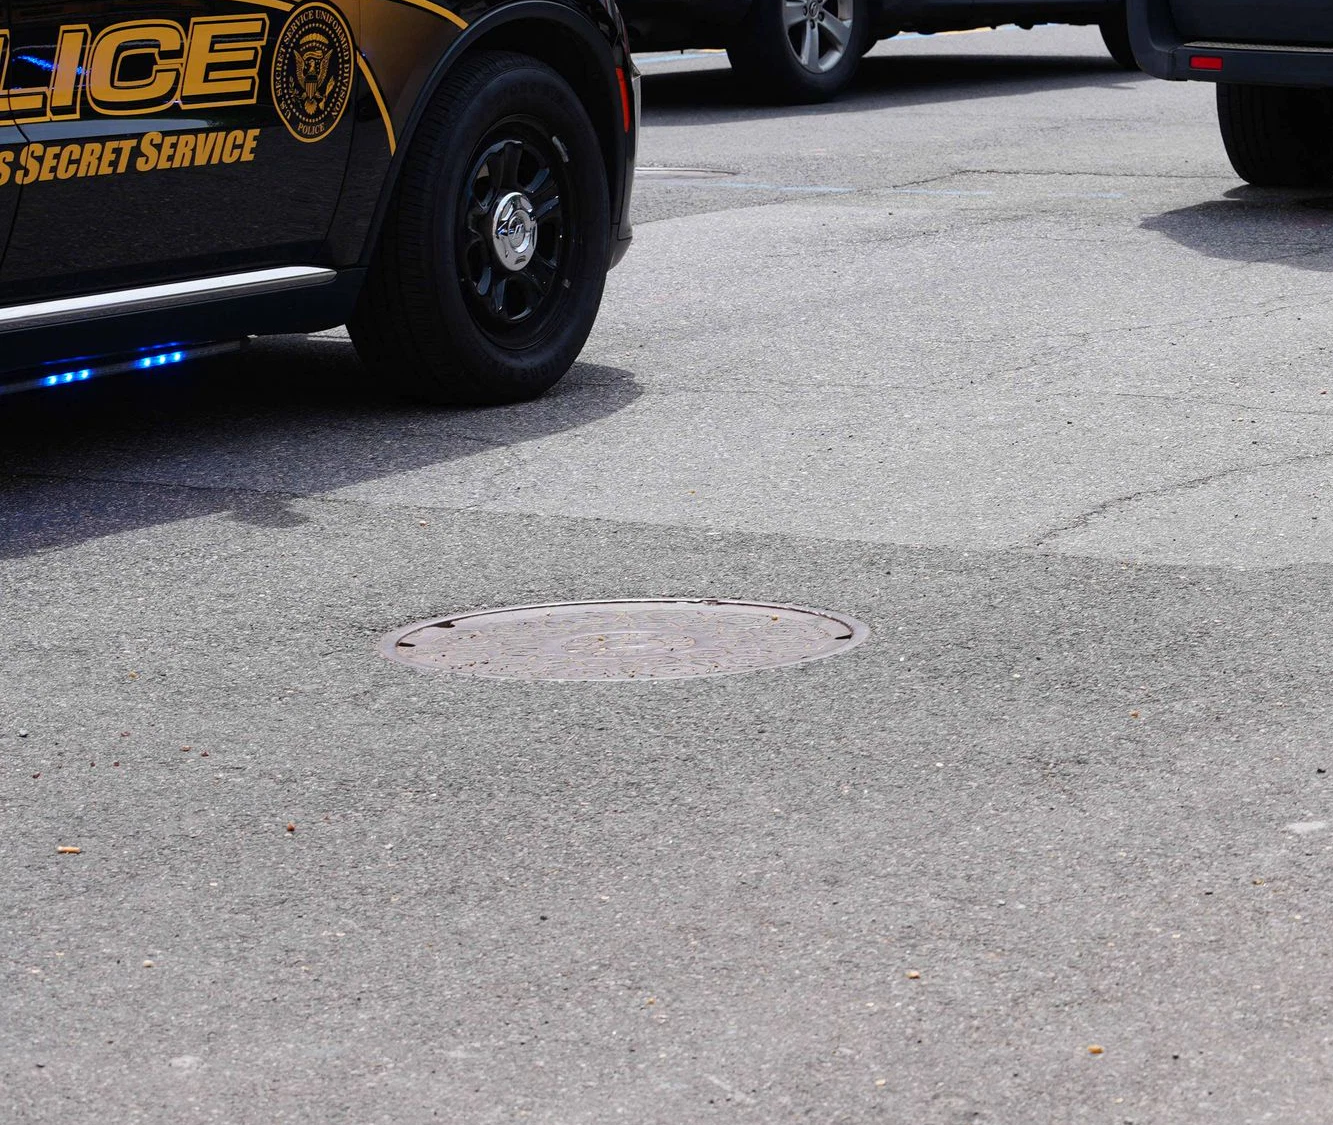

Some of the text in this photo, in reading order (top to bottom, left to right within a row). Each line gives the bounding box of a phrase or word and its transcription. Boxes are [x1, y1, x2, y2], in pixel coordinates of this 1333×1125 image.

[283, 10, 314, 45] SERVICE
[315, 9, 349, 60] UNIFORMED
[0, 13, 269, 126] LICE
[275, 45, 287, 97] SECRET
[331, 63, 350, 119] DIVISION
[297, 122, 325, 135] POLICE
[15, 139, 139, 186] SECRET
[135, 128, 261, 172] SERVICE
